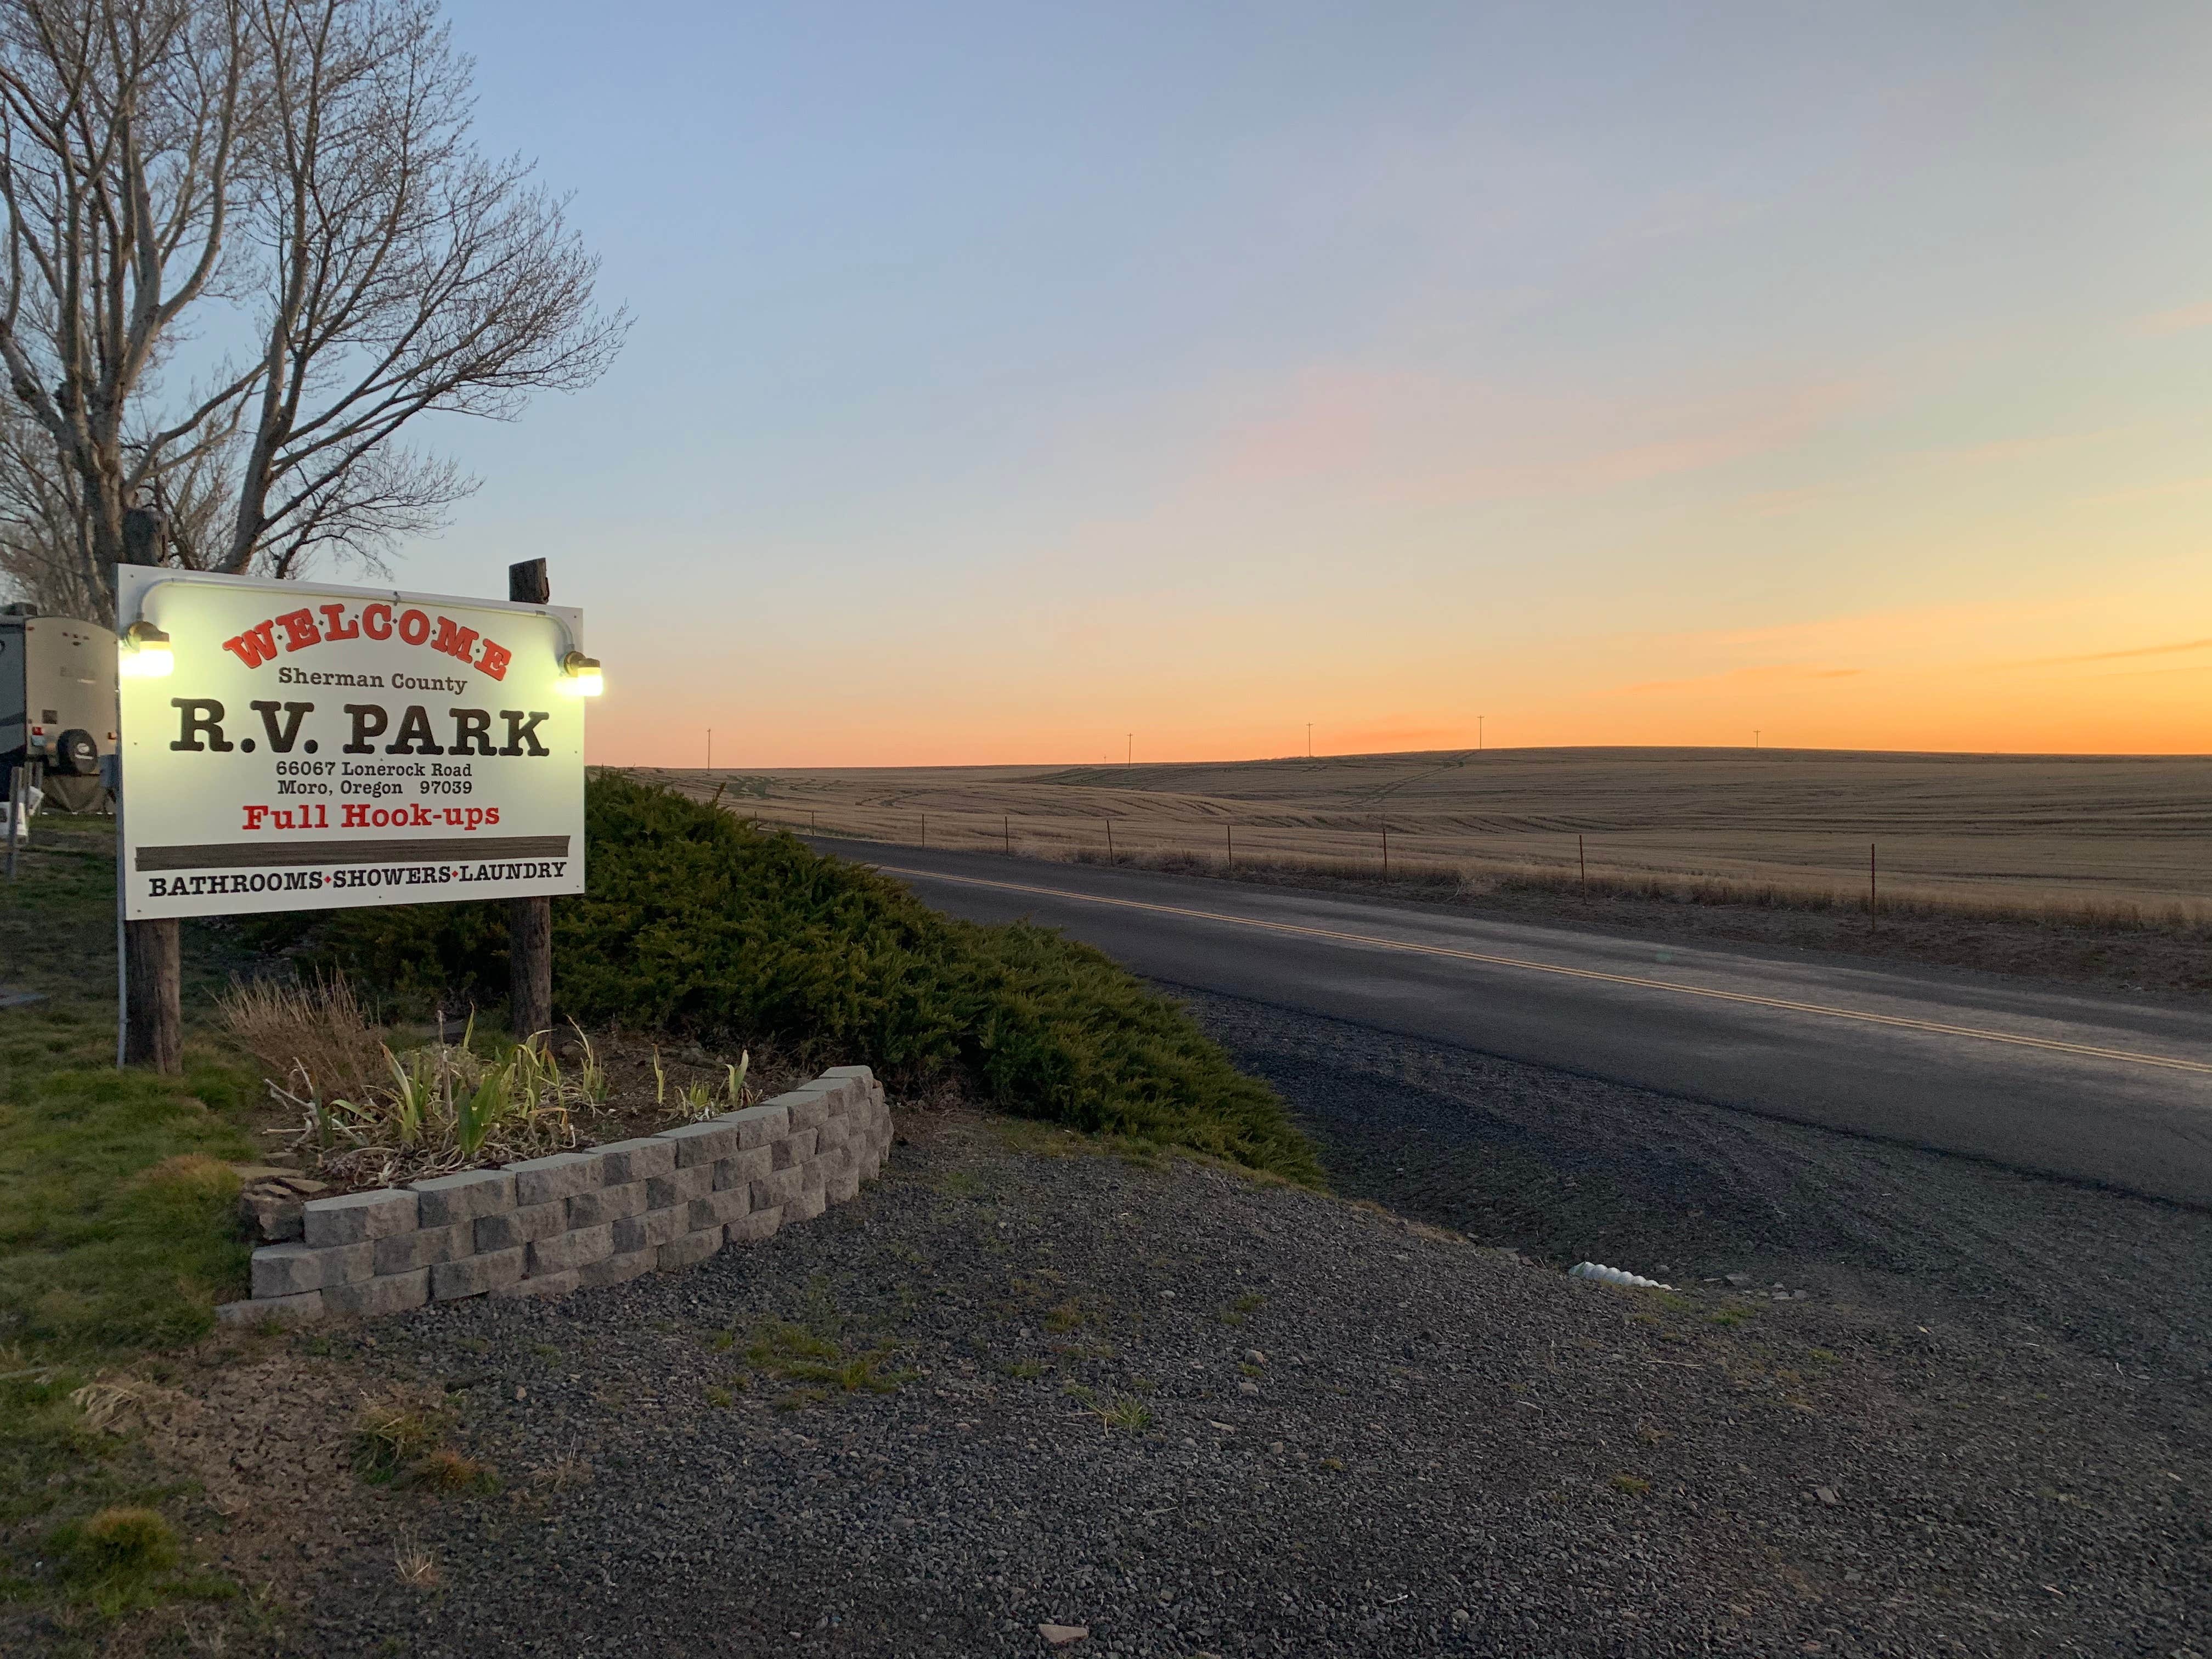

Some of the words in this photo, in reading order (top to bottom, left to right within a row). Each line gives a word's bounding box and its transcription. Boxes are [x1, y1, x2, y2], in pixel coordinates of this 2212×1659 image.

[279, 667, 384, 688] Sherman
[392, 673, 467, 695] County
[170, 698, 318, 753] R.V.
[342, 704, 550, 756] PARK
[276, 761, 335, 776] 66067
[341, 762, 426, 776] Lonerock
[431, 763, 472, 777] Road
[277, 781, 333, 796] Moro,
[340, 781, 403, 798] Oregon
[420, 781, 472, 794] 97039
[242, 805, 328, 830] Full
[341, 803, 500, 831] Hook-ups
[459, 862, 566, 882] LAUNDRY
